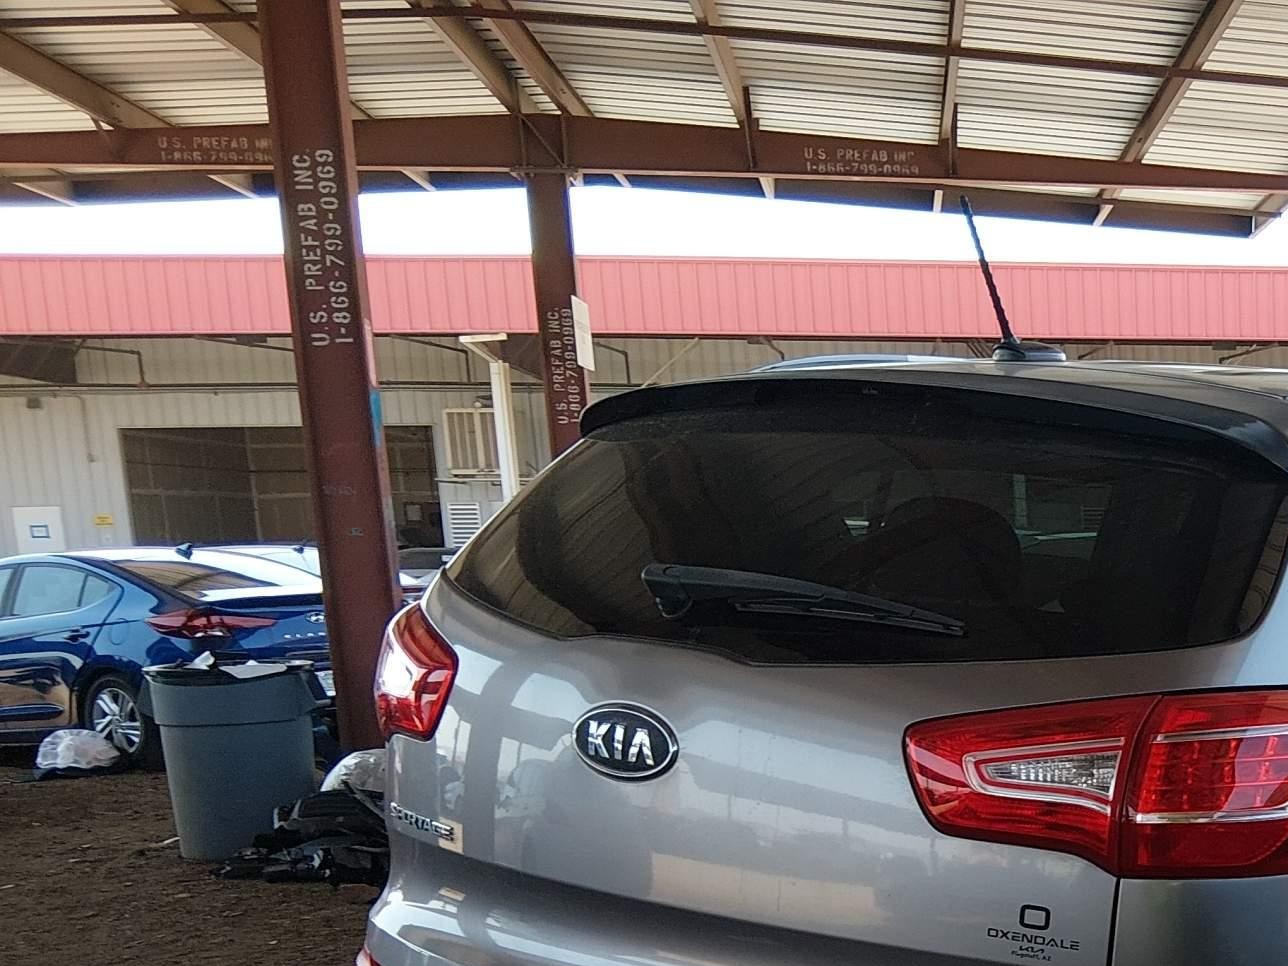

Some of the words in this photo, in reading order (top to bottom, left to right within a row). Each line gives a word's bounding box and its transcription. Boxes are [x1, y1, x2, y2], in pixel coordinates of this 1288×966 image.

[158, 136, 186, 150] U.S.
[193, 136, 248, 150] PREFAB
[836, 148, 888, 162] PREFAB
[297, 202, 325, 291] PREFAB
[315, 148, 354, 345] 1-866-799-0969
[309, 303, 331, 347] U.S.
[547, 306, 561, 333] INC.
[549, 339, 566, 392] PREFAB
[587, 720, 655, 766] KIA
[987, 927, 1080, 951] OXENDALE
